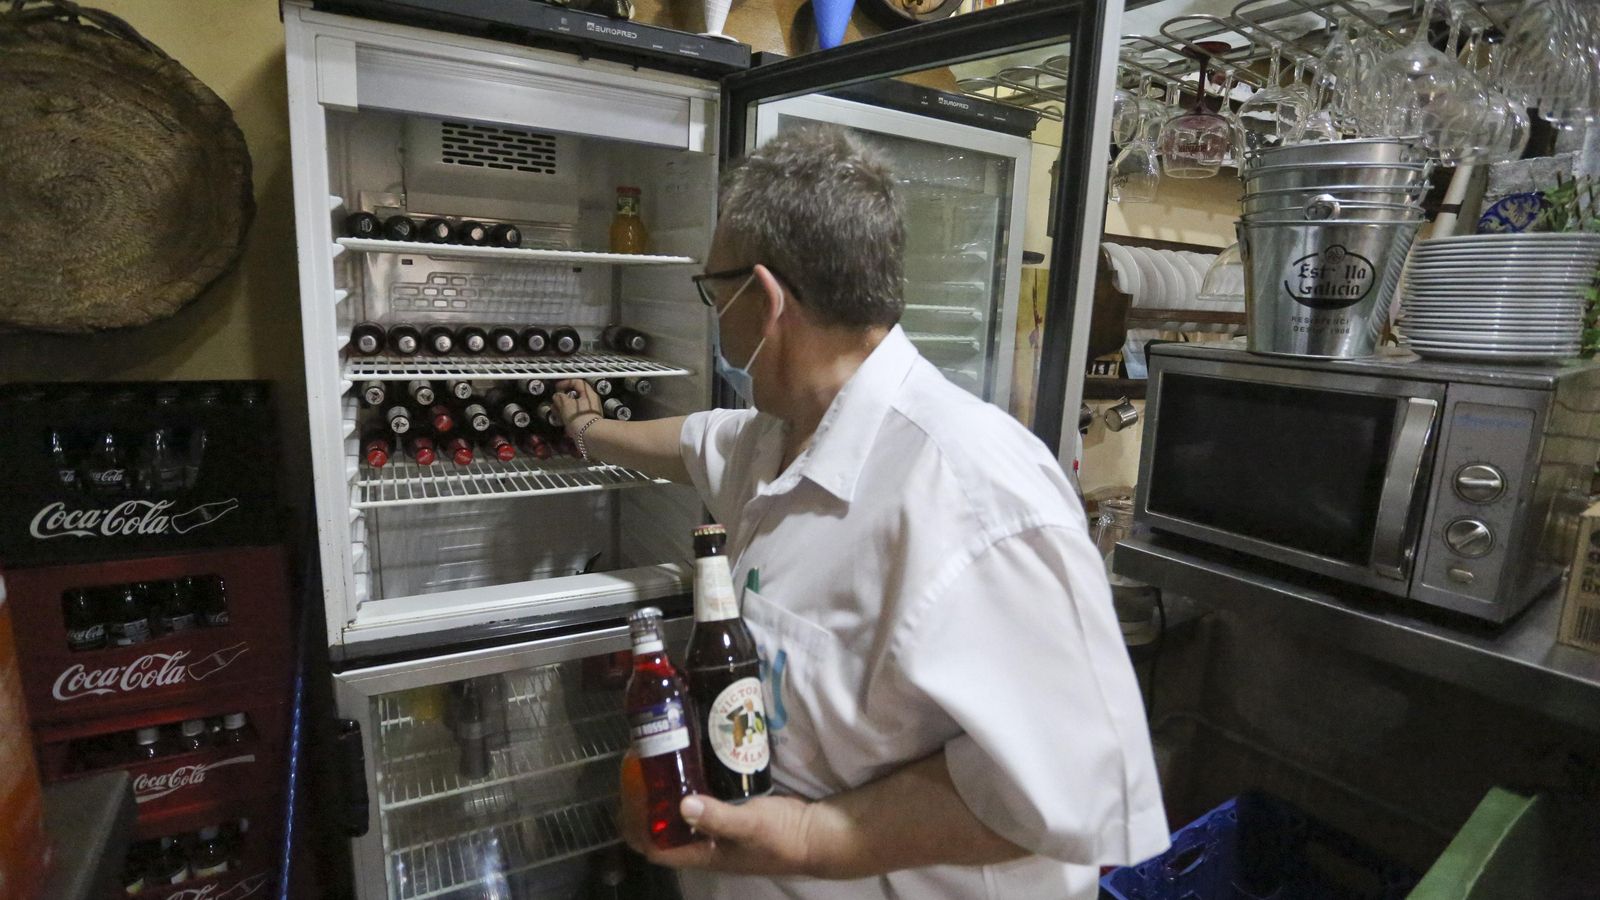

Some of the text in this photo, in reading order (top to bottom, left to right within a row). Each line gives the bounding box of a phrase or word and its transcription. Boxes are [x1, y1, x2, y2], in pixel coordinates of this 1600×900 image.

[594, 25, 638, 39] EUROFRED
[1298, 263, 1366, 280] Estlla
[29, 500, 176, 539] Coca-Cola
[52, 650, 192, 700] Coca-Cola
[132, 763, 208, 797] Coca-Cola
